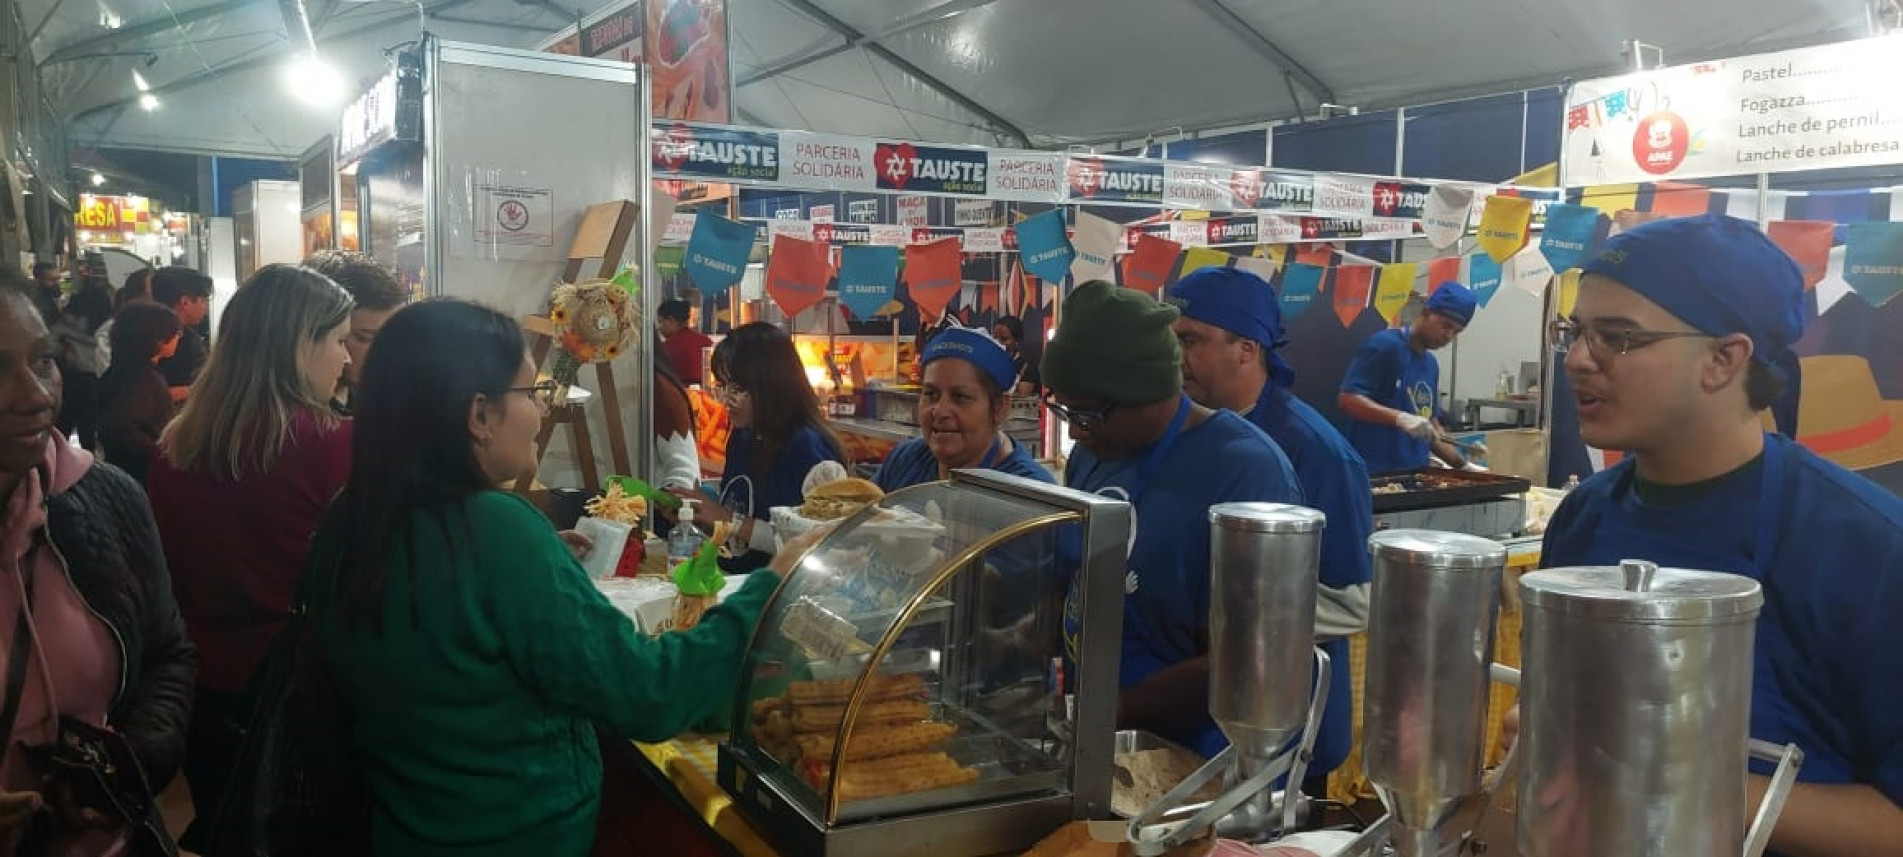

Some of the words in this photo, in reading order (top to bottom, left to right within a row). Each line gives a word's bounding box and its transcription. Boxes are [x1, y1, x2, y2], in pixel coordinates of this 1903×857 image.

[1739, 119, 1797, 138] Lanche
[1801, 116, 1822, 132] de
[687, 140, 777, 167] TAUSTE
[795, 143, 861, 162] PARCERIA
[1736, 146, 1792, 162] Lanche
[1795, 144, 1815, 159] de
[1818, 140, 1899, 156] calabresa
[792, 160, 865, 180] SOLIDÁRIA
[909, 158, 986, 182] TAUSTE
[999, 159, 1055, 175] PARCERIA
[996, 175, 1058, 192] SOLIDÁRIA
[1098, 171, 1162, 192] TAUSTE
[1258, 182, 1313, 202] TAUSTE
[1222, 223, 1257, 237] TAUSTE
